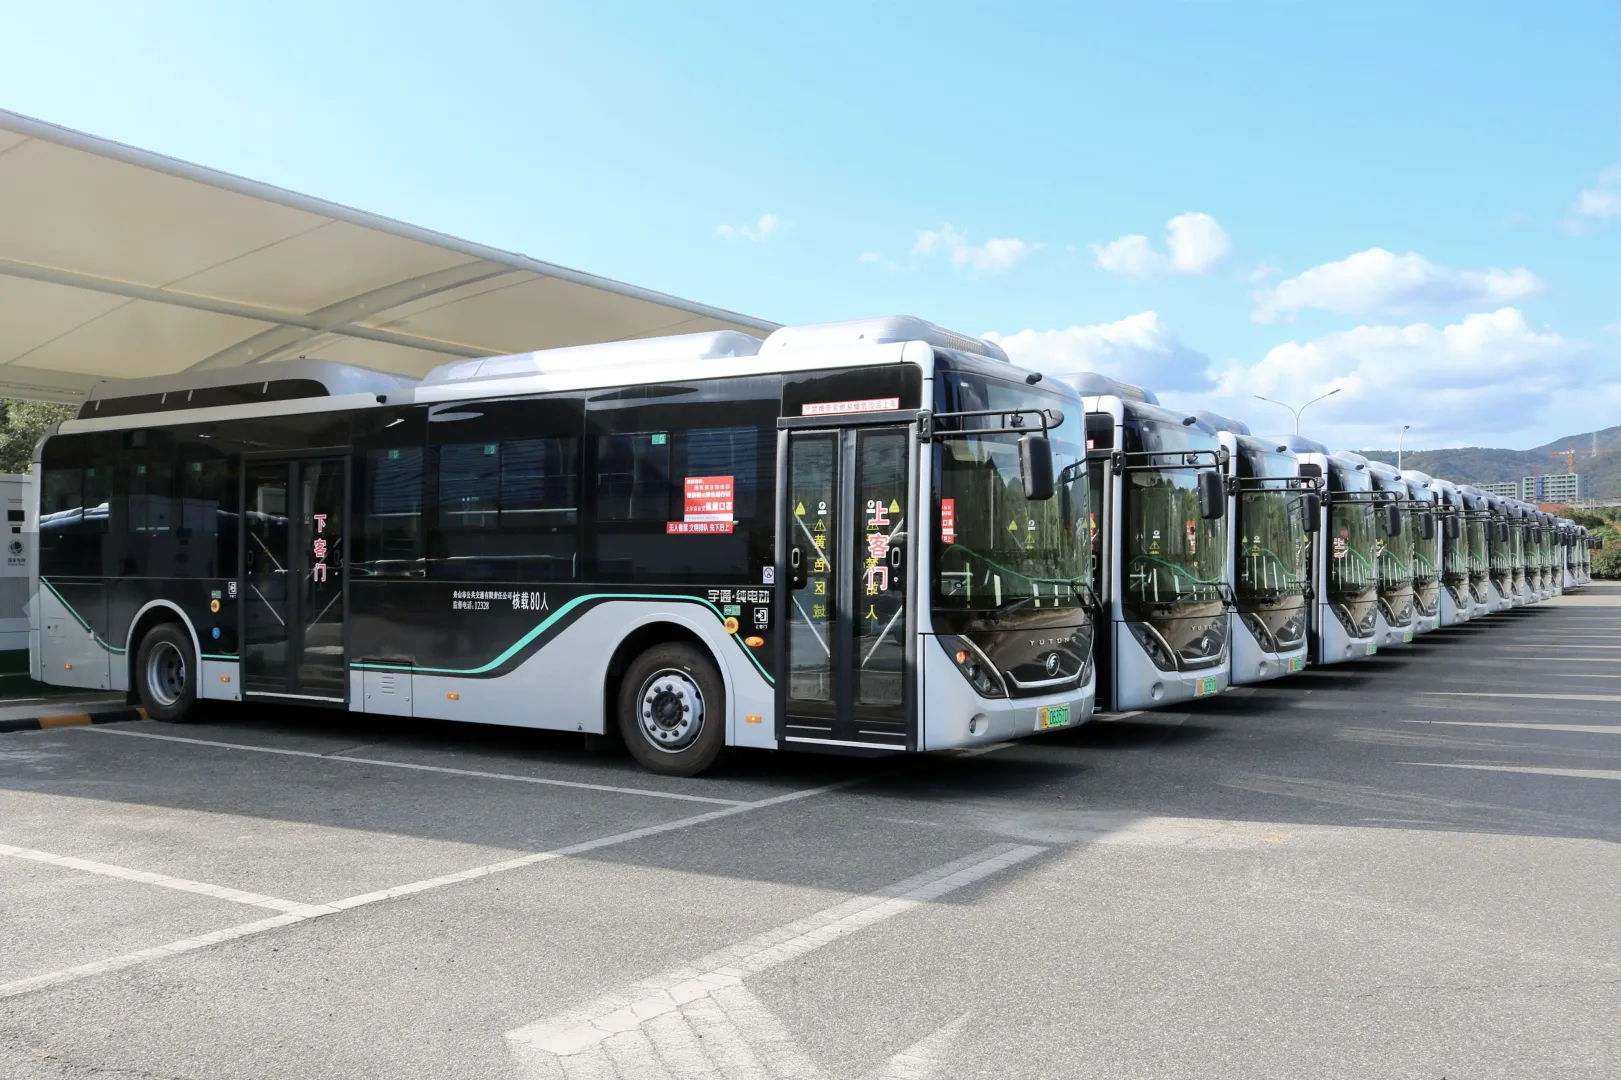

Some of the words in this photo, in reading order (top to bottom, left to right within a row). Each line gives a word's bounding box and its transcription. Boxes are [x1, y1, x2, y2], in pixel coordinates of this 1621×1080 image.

[314, 514, 327, 582] 下客门
[868, 500, 890, 591] 上客门
[512, 591, 549, 611] 核载80人
[1029, 636, 1077, 646] YUTONG
